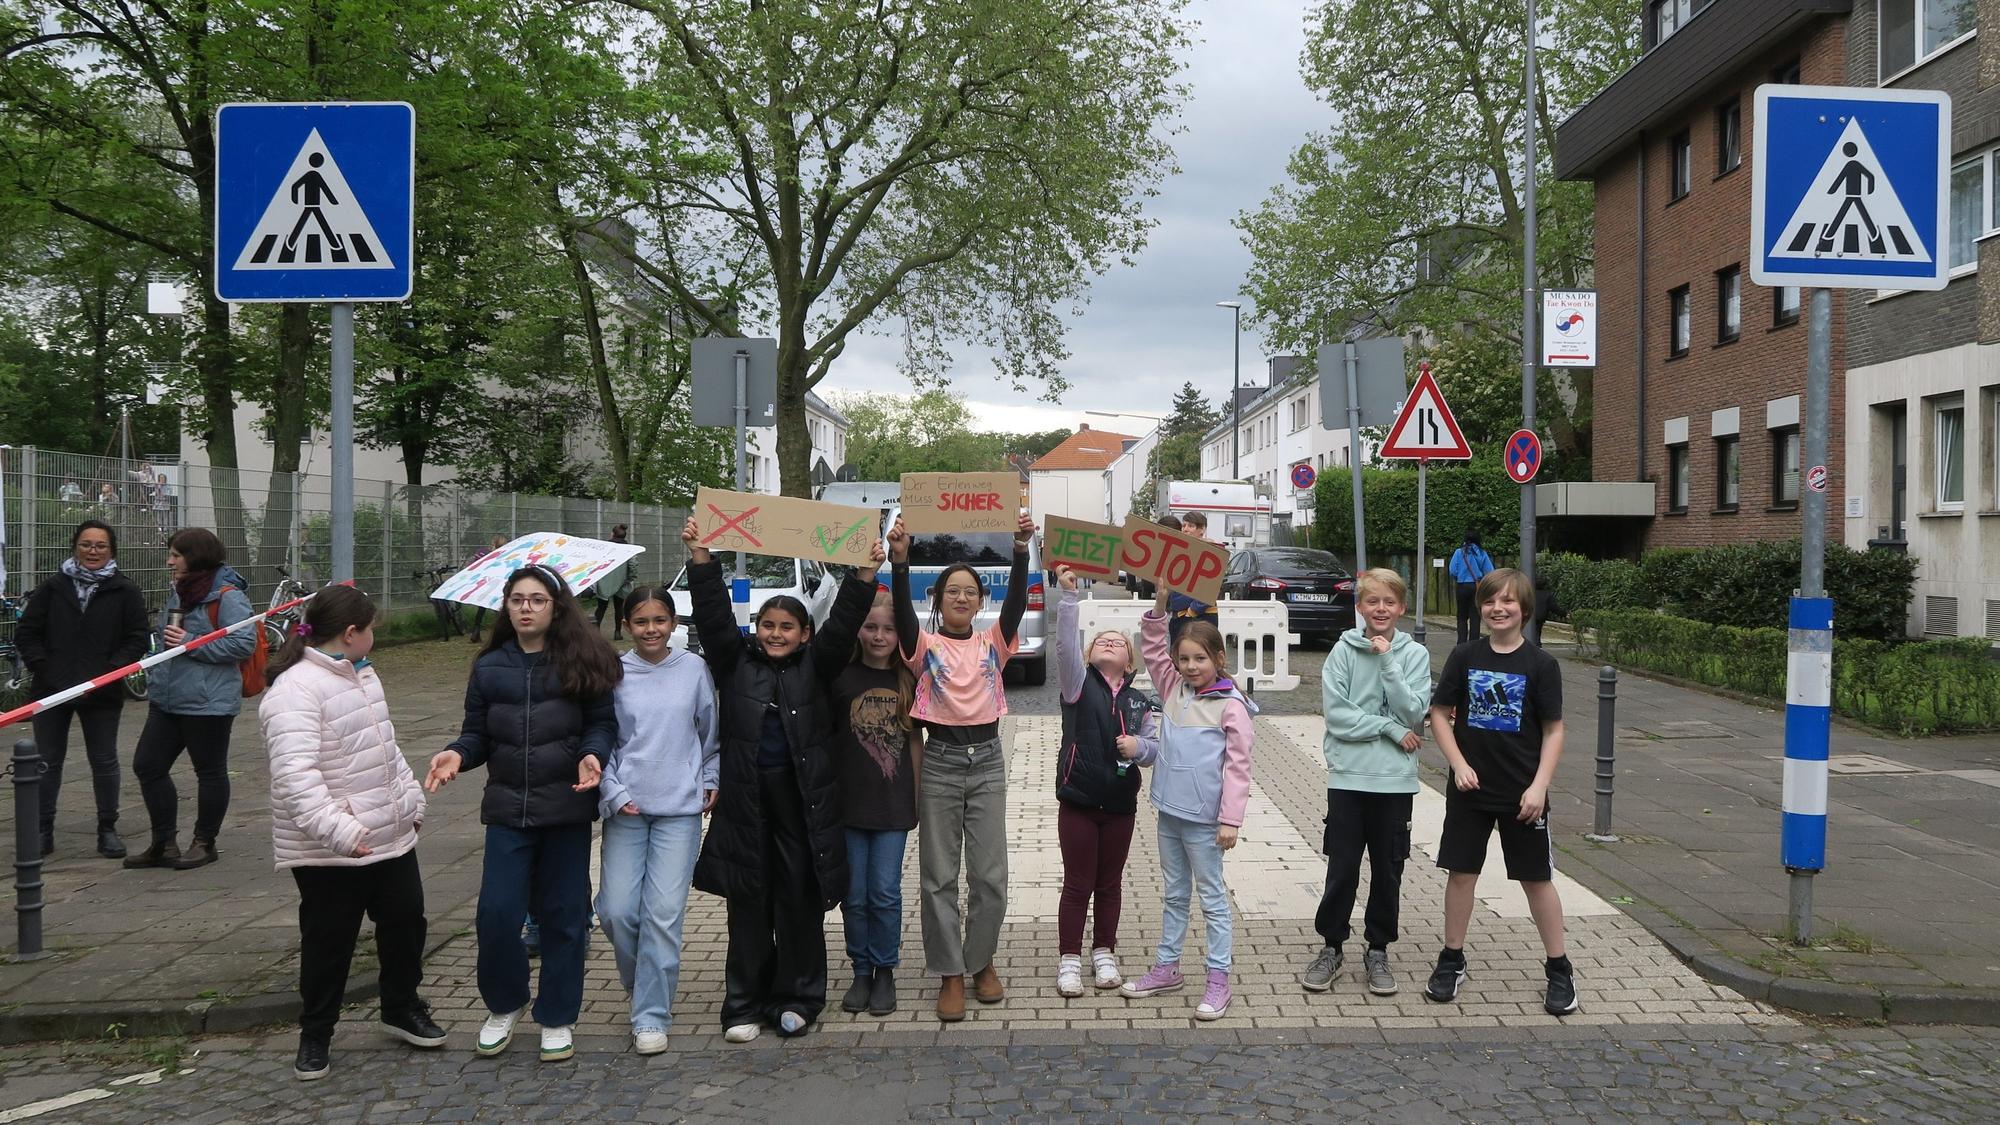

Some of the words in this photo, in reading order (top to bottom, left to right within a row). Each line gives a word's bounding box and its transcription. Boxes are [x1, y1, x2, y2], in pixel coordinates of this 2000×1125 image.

[1547, 299, 1559, 307] Tae
[1561, 299, 1582, 307] Kwon
[1584, 299, 1594, 307] Do
[904, 476, 926, 491] Der
[937, 476, 993, 492] Erlenweg
[936, 492, 1004, 512] SICHER
[1121, 529, 1222, 593] STOP
[980, 574, 1010, 586] OLIZ
